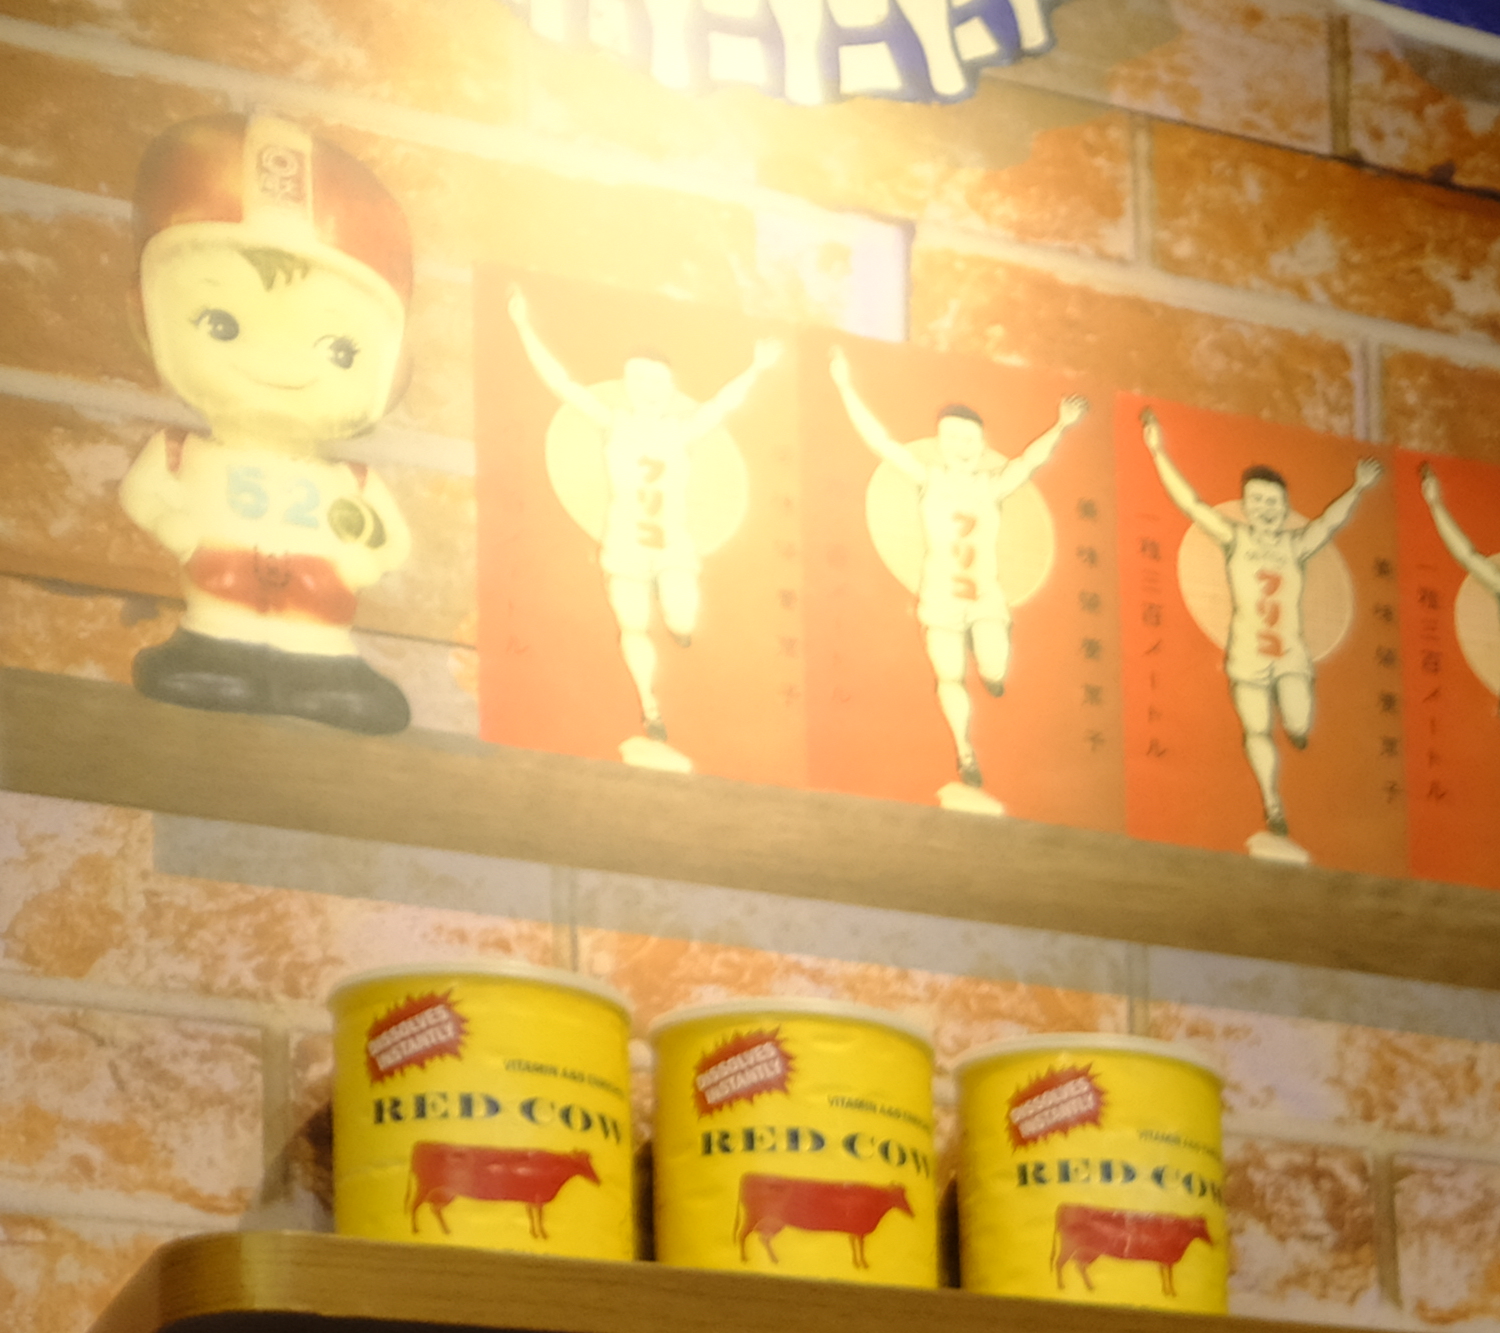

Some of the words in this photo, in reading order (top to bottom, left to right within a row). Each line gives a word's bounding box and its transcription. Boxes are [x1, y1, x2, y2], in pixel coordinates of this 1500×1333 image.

[373, 1091, 501, 1125] RED
[519, 1096, 623, 1145] COW
[700, 1125, 826, 1157] RED
[841, 1131, 931, 1179] COW
[1016, 1158, 1137, 1188] RED
